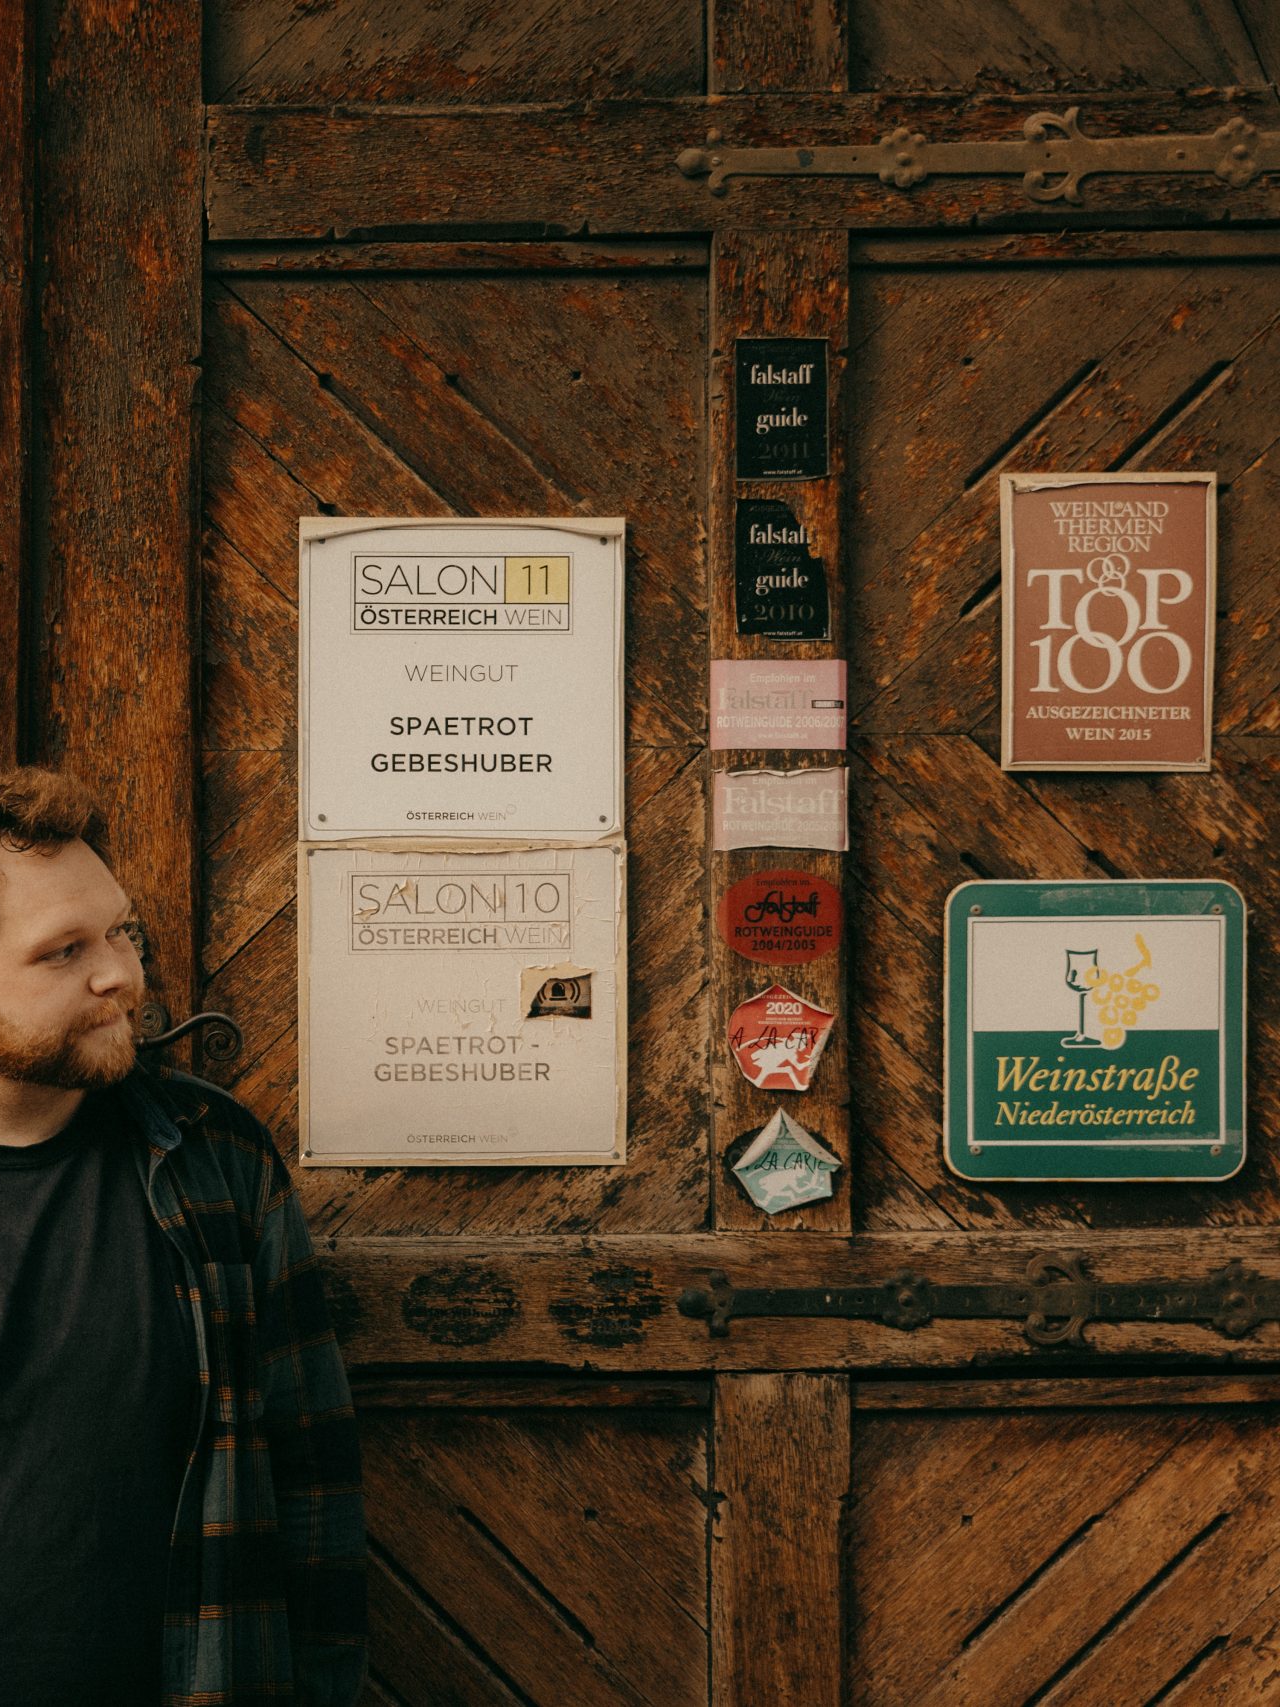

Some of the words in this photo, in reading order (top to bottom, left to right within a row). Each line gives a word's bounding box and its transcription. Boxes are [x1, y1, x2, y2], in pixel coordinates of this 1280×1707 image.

[750, 363, 815, 385] falstaff
[756, 406, 809, 435] guide
[1049, 501, 1169, 518] WEINLAND
[1054, 518, 1163, 535] THERMEN
[1068, 535, 1151, 553] REGION
[360, 564, 497, 596] SALON
[521, 564, 549, 595] 11
[755, 567, 809, 596] guide
[360, 605, 497, 625] ÖSTERREICH
[504, 609, 562, 625] WEIN
[753, 603, 815, 621] 2010
[1027, 568, 1194, 648] TOP
[1030, 631, 1193, 695] 100
[405, 664, 518, 682] WEINGUT
[1026, 705, 1191, 720] AUSGEZEICHNETER
[390, 717, 533, 736] SPAETROT
[716, 716, 792, 728] ROTWEINGUIDE
[1065, 727, 1115, 741] WEIN
[1118, 728, 1151, 741] 2015
[371, 754, 552, 773] GEBESHUBER
[722, 787, 844, 815] Falstaff
[406, 810, 474, 821] ÖSTERREICH
[477, 812, 507, 821] WEIN
[358, 883, 497, 915] SALON
[515, 883, 560, 914] 10
[358, 925, 496, 945] ÖSTERREICH
[504, 927, 563, 944] WEIN
[734, 926, 833, 937] ROTWEINGUIDE
[751, 939, 816, 951] 2004/2005
[417, 999, 506, 1013] WEINGUT
[765, 1002, 803, 1015] 2020
[385, 1036, 521, 1054] SPAETROT
[728, 1026, 744, 1048] A
[748, 1026, 782, 1049] LA
[785, 1026, 821, 1049] CAR
[374, 1063, 550, 1081] GEBESHUBER
[995, 1055, 1200, 1100] Weinstraße
[994, 1100, 1196, 1127] Niederösterreich
[407, 1132, 475, 1143] ÖSTERREICH
[479, 1135, 508, 1143] WEIN
[755, 1151, 778, 1170] LA
